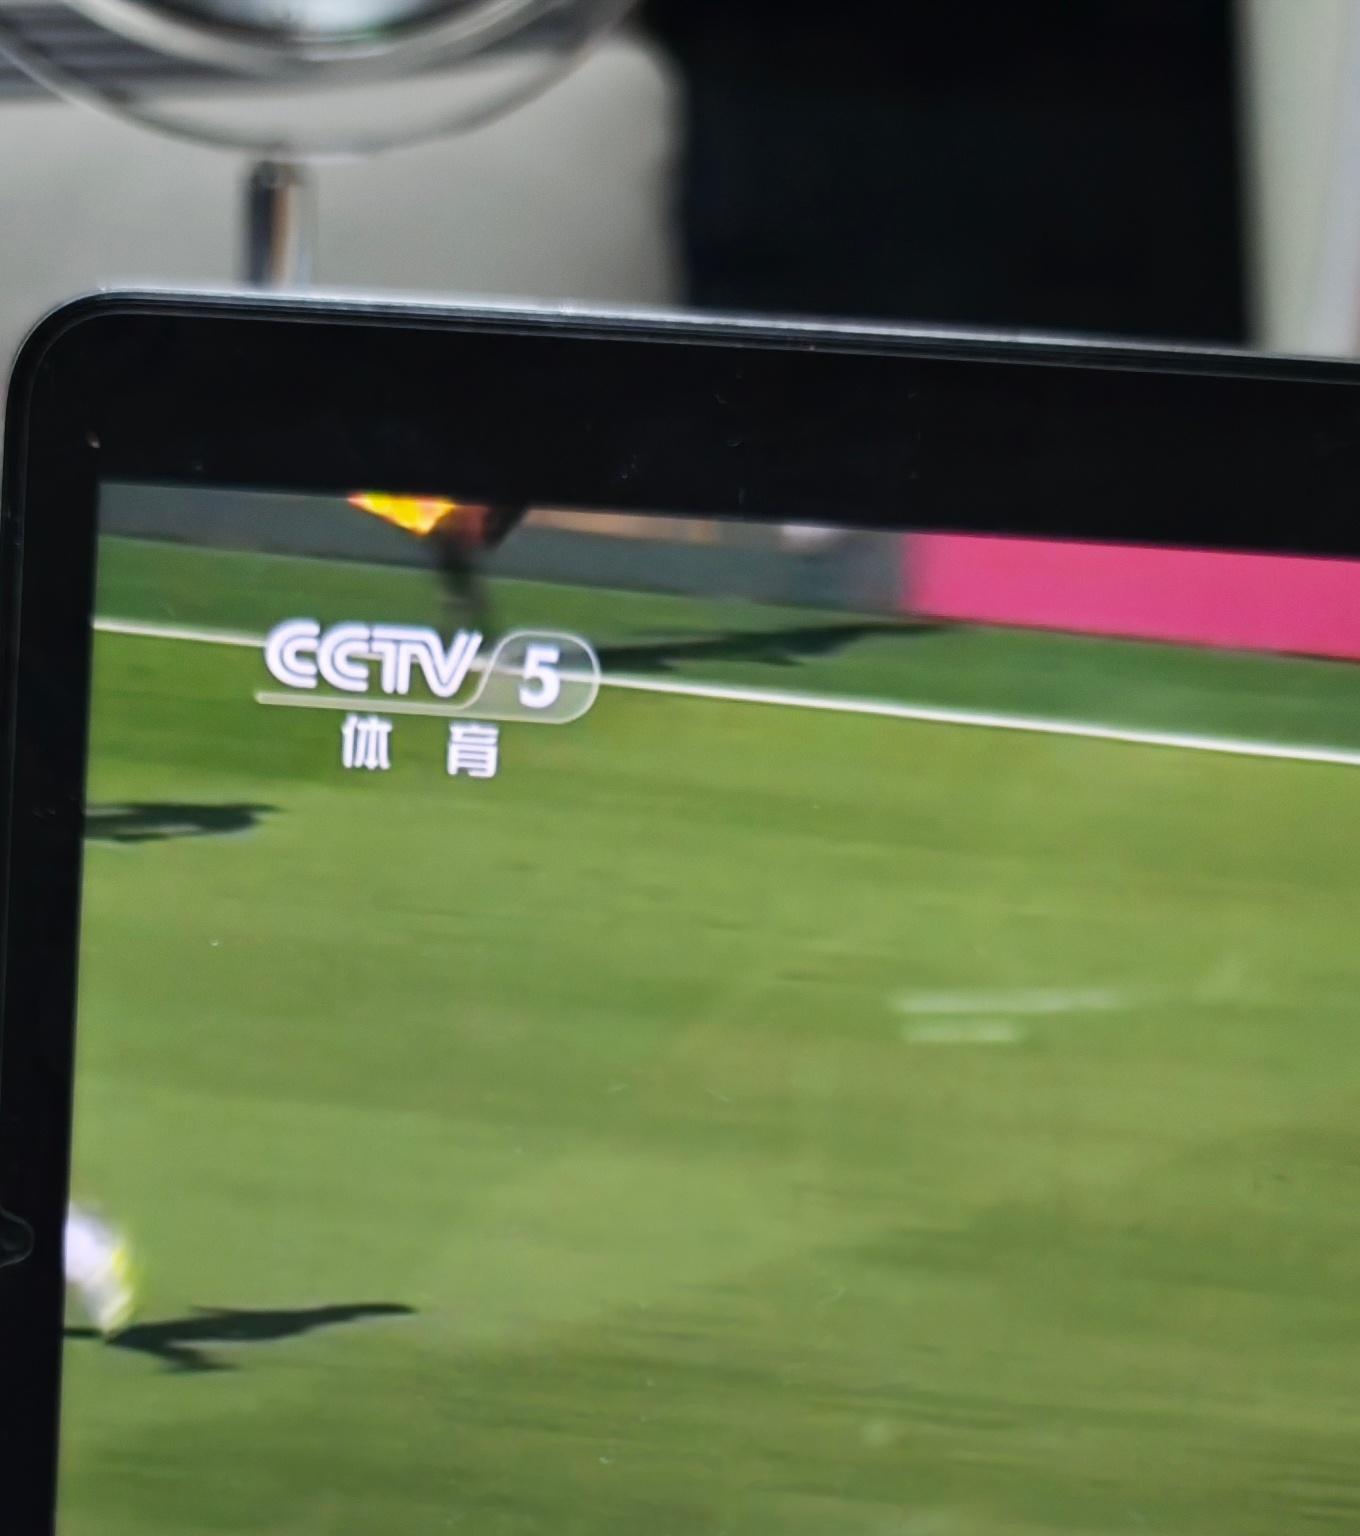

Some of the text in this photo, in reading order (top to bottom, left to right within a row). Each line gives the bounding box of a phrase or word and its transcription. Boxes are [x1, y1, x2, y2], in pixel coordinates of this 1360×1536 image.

[262, 617, 562, 709] CCTV 5
[341, 713, 500, 779] 体育
